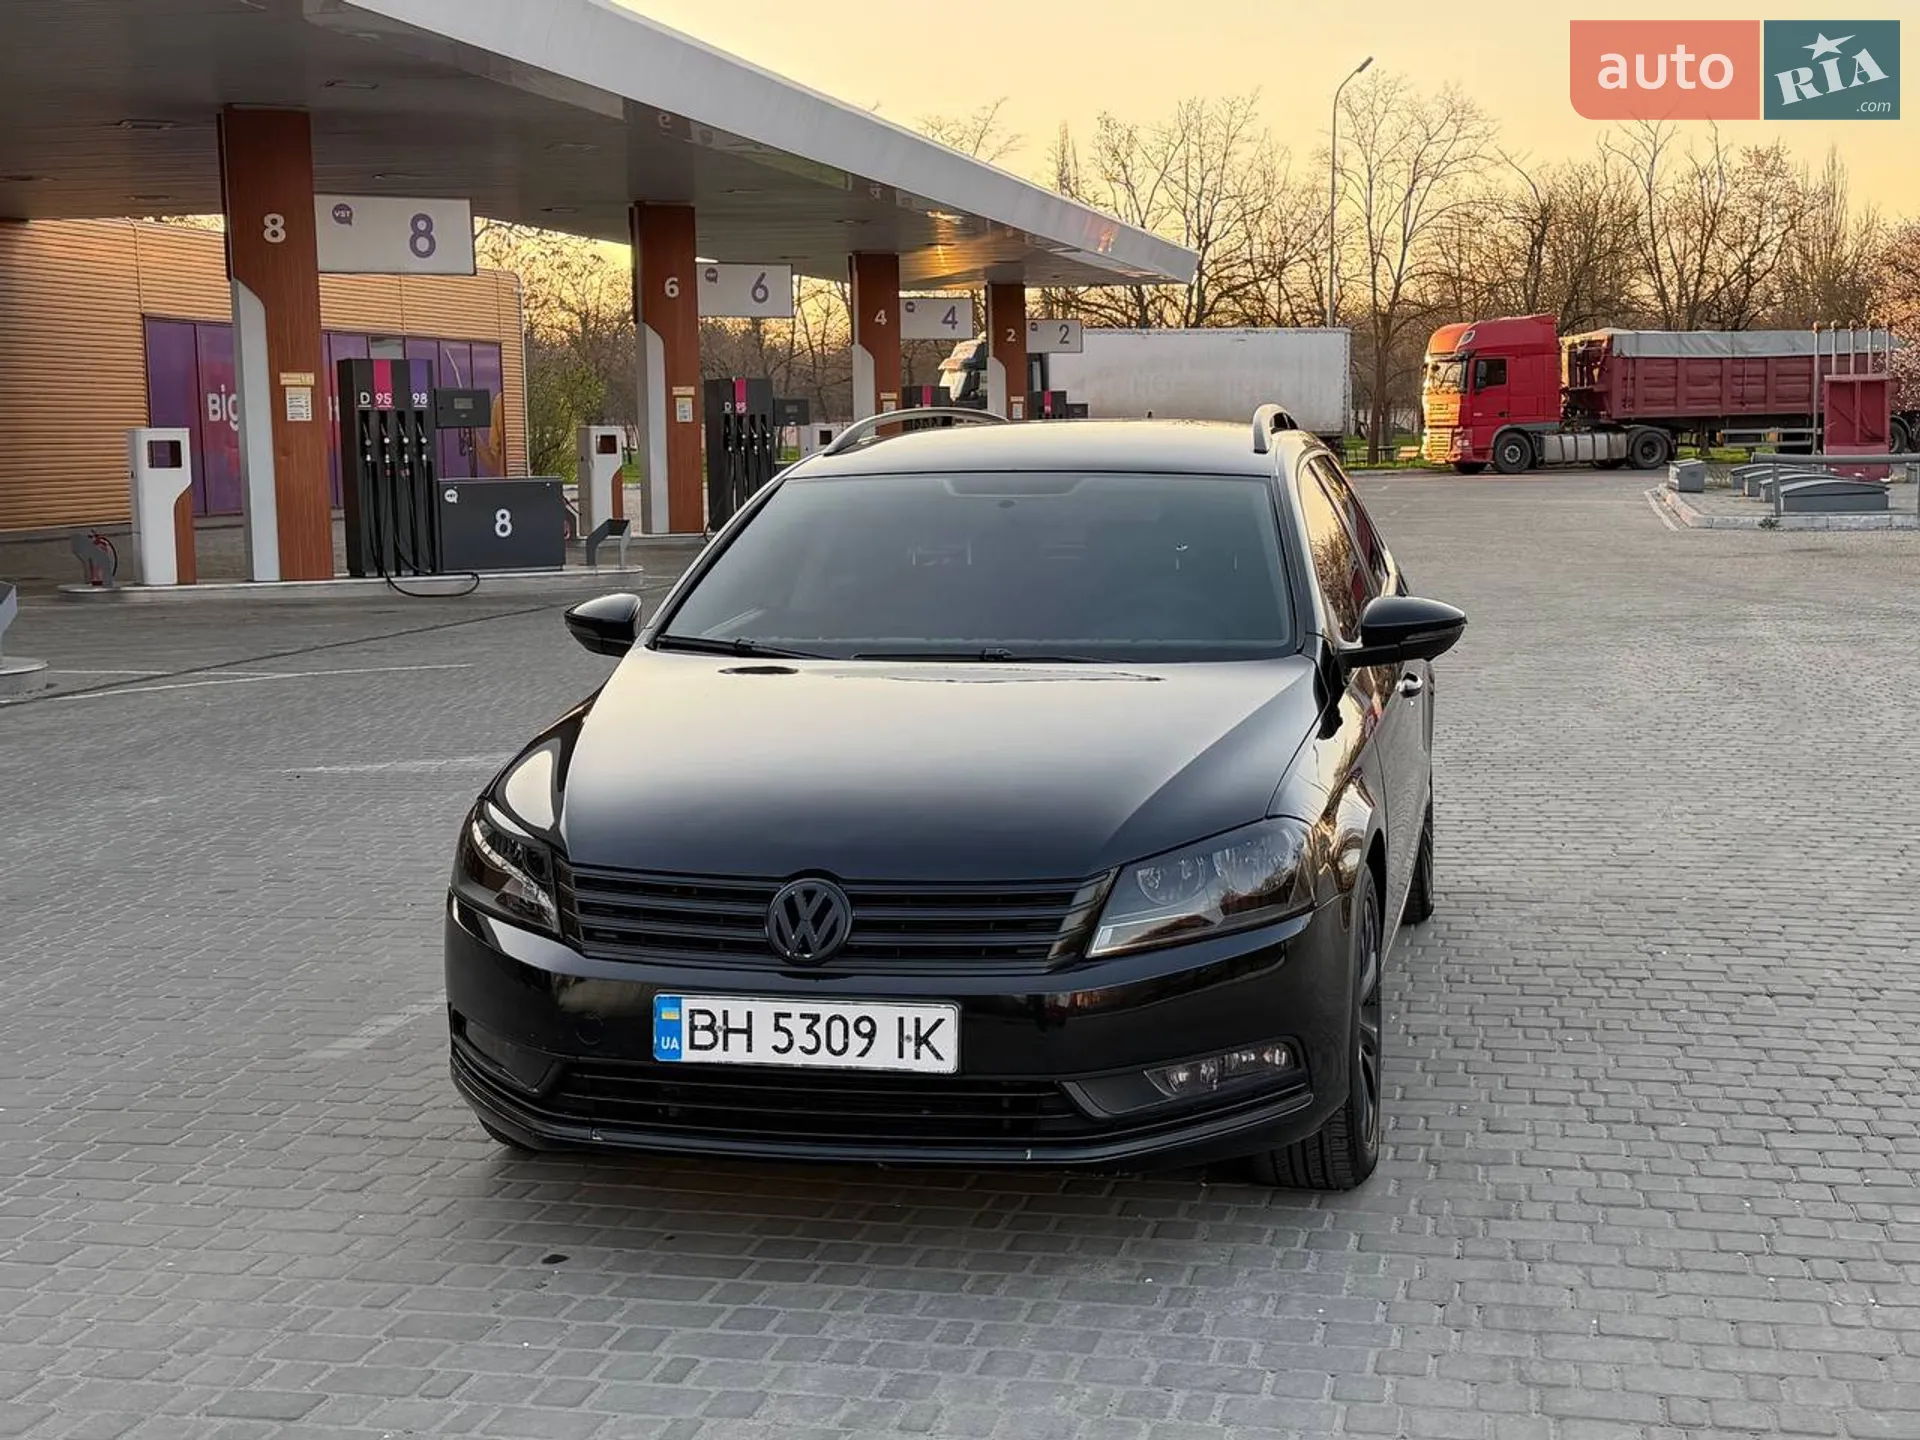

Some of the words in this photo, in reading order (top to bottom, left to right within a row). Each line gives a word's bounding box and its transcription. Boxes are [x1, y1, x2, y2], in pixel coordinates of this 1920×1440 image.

[263, 213, 287, 243] 8
[409, 212, 437, 259] 8
[664, 276, 680, 298] 6
[751, 271, 769, 304] 6
[874, 309, 888, 326] 4
[941, 305, 959, 331] 4
[1005, 328, 1017, 342] 2
[1058, 324, 1070, 345] 2
[359, 391, 370, 405] D
[375, 392, 392, 405] 95
[412, 392, 428, 405] 98
[494, 508, 513, 538] 8
[661, 1037, 680, 1051] UA
[688, 1008, 753, 1054] BH
[771, 1011, 878, 1058] 5309
[897, 1015, 946, 1062] IK
